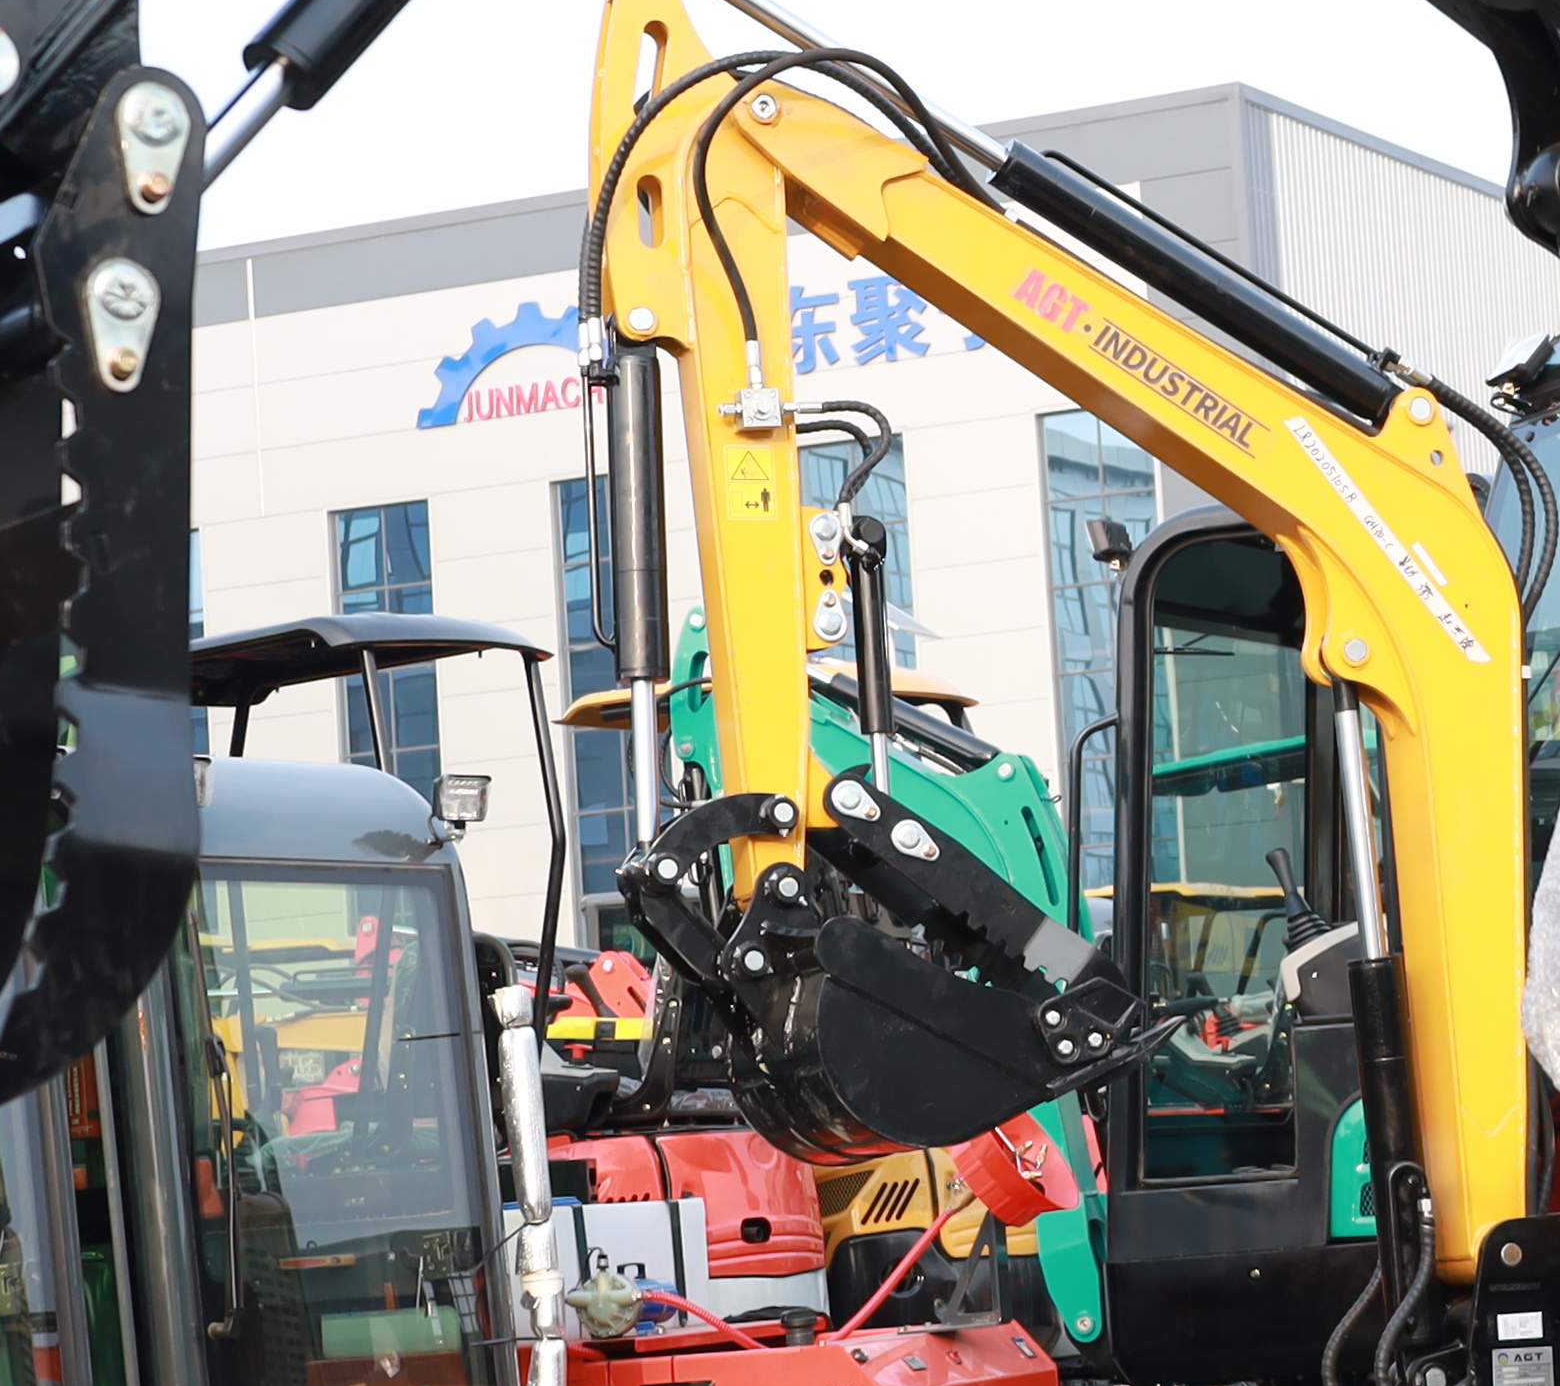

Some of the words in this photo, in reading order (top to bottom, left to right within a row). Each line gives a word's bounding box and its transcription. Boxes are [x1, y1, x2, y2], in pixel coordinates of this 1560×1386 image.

[790, 275, 987, 375] 东聚
[1013, 269, 1089, 333] AGT
[1092, 324, 1256, 452] INDUSTRIAL
[1513, 1352, 1544, 1363] AGT
